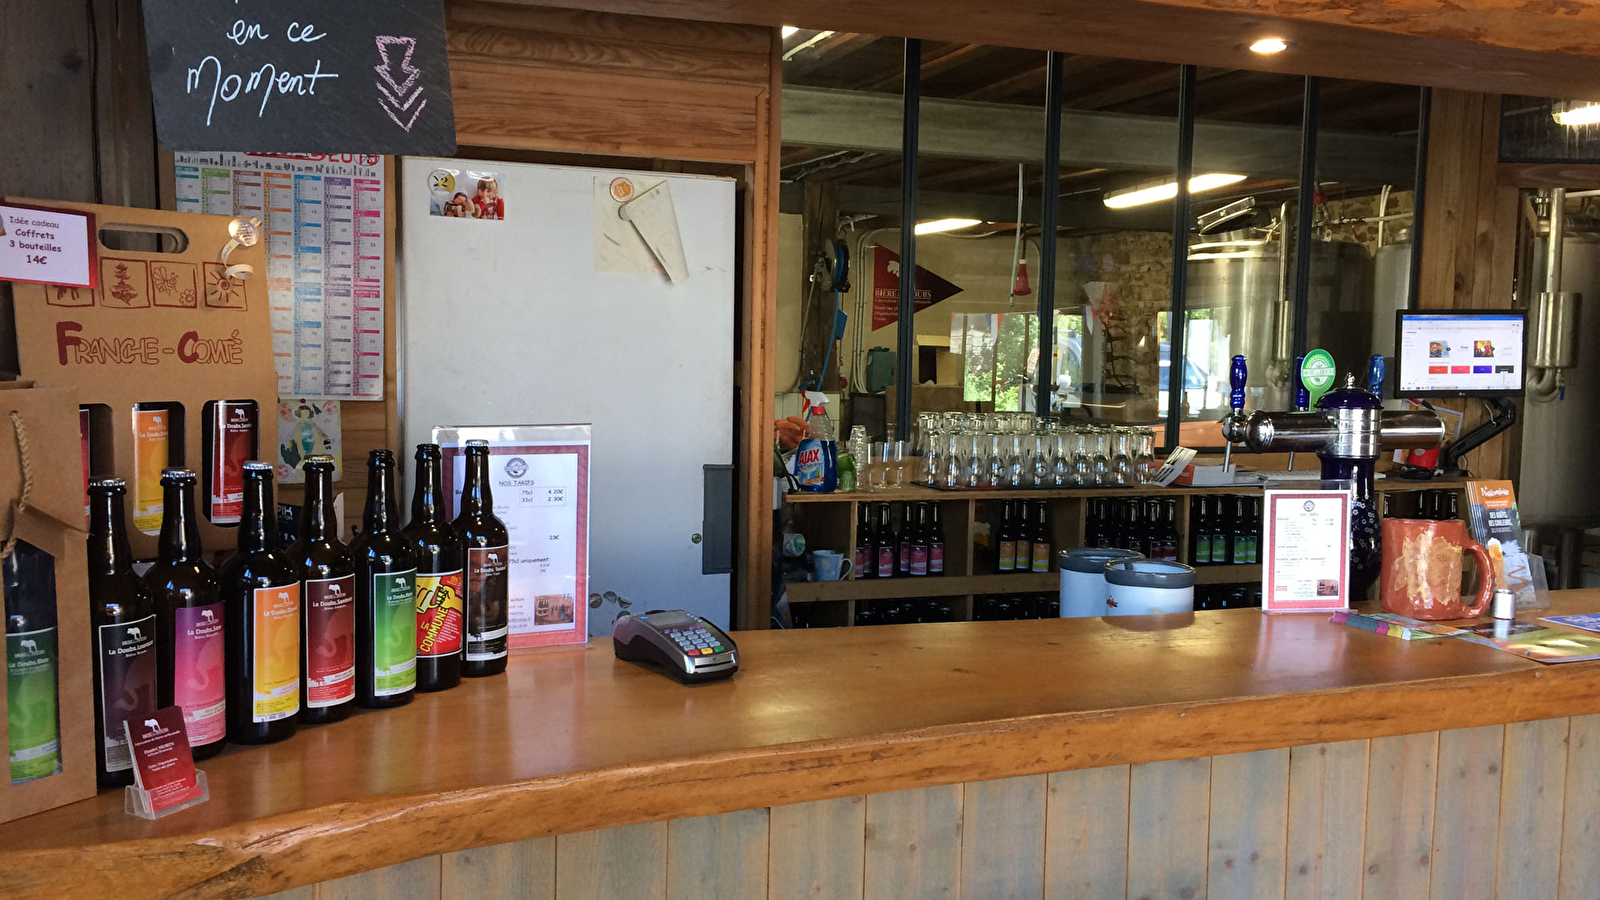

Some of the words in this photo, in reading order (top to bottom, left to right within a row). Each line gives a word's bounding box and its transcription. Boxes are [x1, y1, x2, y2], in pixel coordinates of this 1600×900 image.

[226, 19, 269, 45] en
[287, 21, 327, 42] ce
[9, 215, 29, 225] Idée
[31, 220, 60, 228] cadeau
[15, 229, 55, 240] Coffrets
[19, 241, 62, 252] bouteilles
[26, 254, 47, 264] 14€
[798, 449, 820, 466] AJAX
[420, 606, 449, 652] COMMUNE
